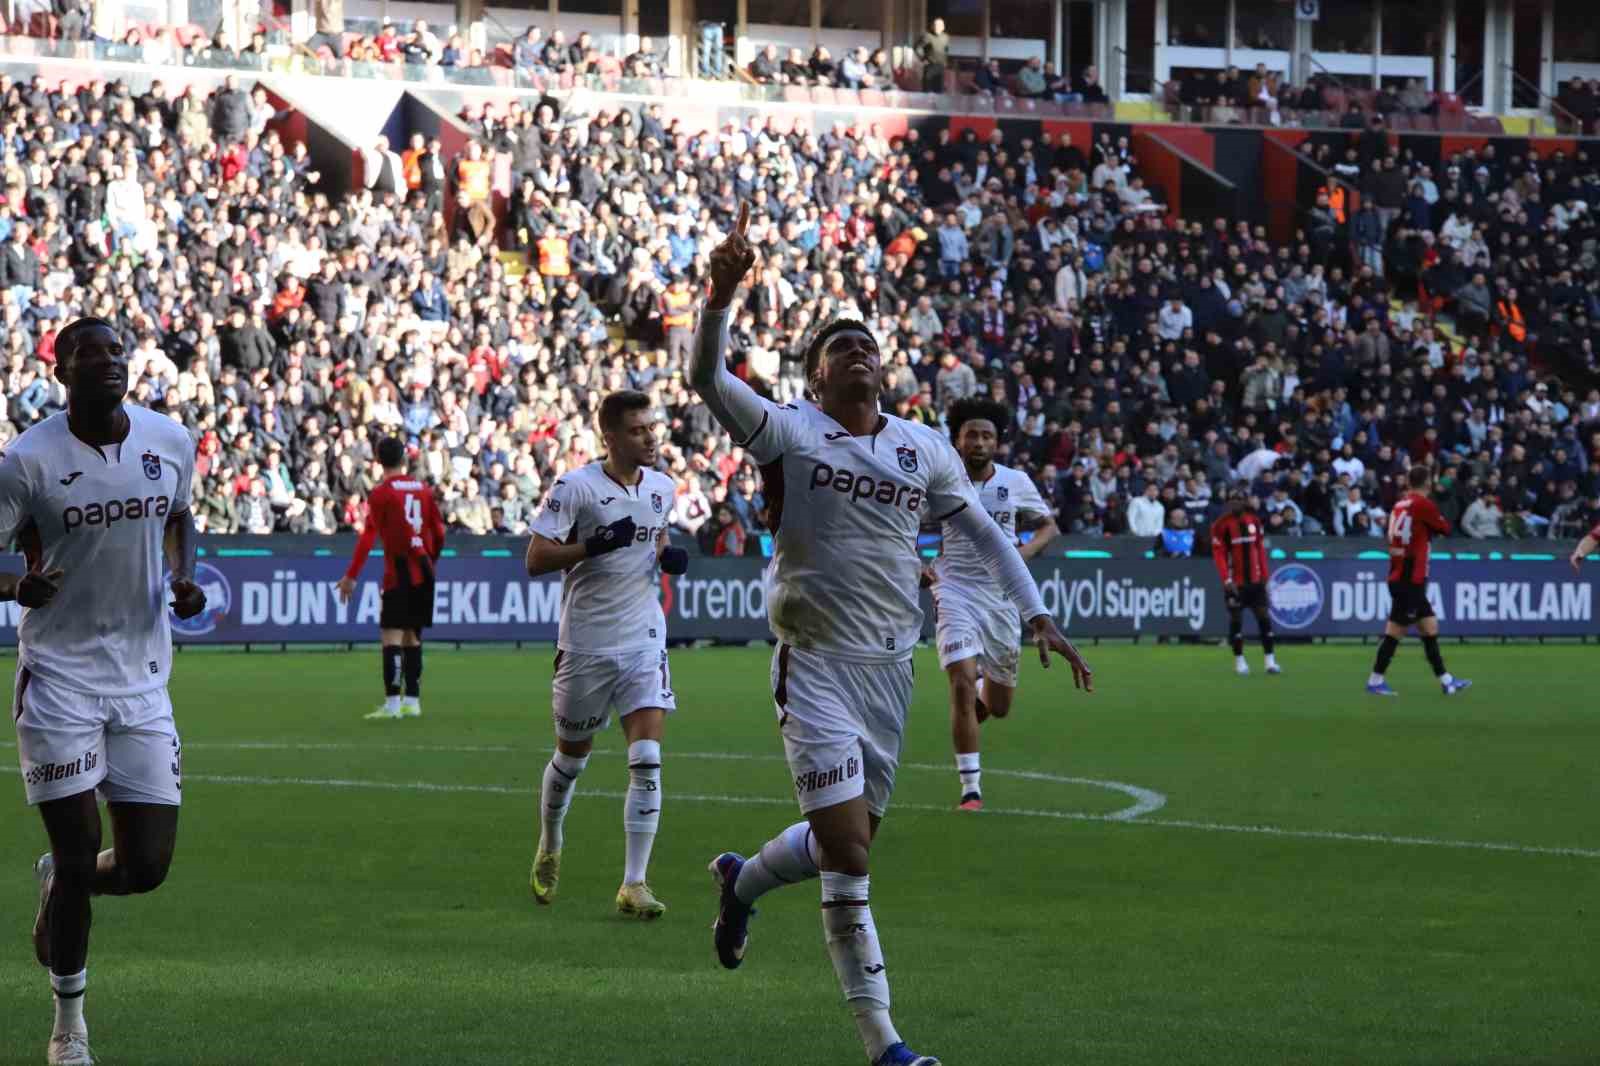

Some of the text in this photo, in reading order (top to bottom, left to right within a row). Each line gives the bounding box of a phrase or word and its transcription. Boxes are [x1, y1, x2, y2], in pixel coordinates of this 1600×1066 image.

[810, 463, 922, 512] papara
[62, 495, 169, 534] papara
[404, 493, 423, 535] 4
[433, 581, 562, 625] EKLAM
[676, 567, 770, 619] trend
[1039, 567, 1103, 630] dyol
[1331, 571, 1446, 620] DÜNA
[1455, 582, 1592, 621] REKLAM
[44, 757, 82, 783] Rent
[807, 764, 844, 793] Rent
